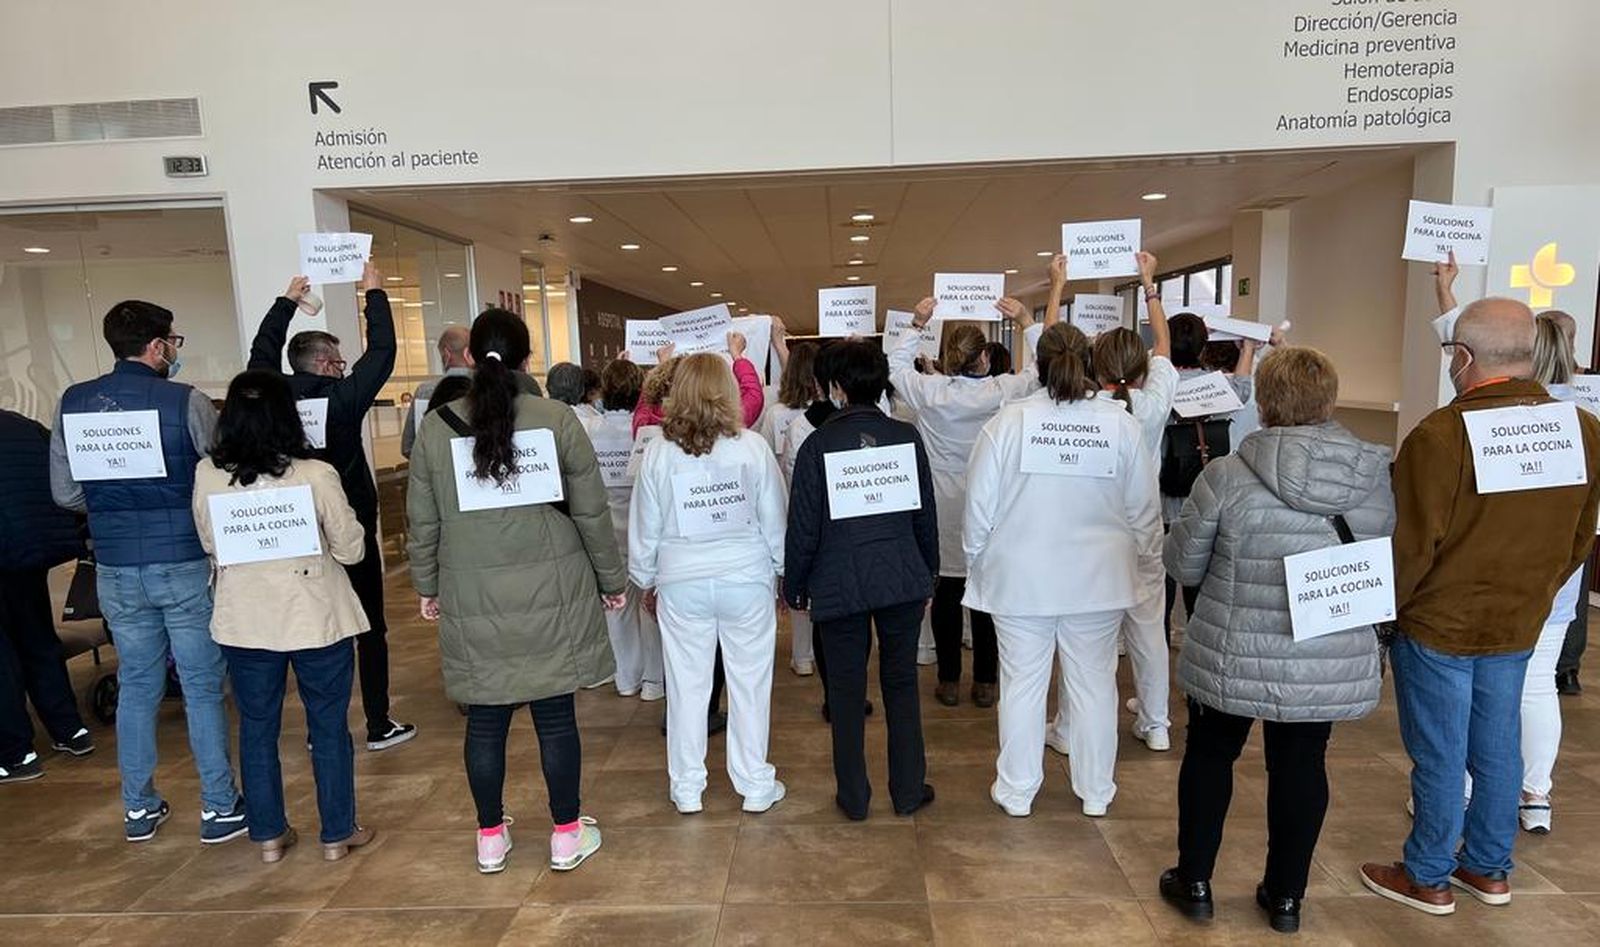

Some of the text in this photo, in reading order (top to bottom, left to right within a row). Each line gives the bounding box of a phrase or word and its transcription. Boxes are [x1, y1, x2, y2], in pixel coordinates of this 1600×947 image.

[1294, 9, 1457, 32] Dirección/Gerencia
[1284, 33, 1456, 58] Medicina preventiva
[1344, 58, 1455, 79] Hemoterapia
[1347, 83, 1453, 103] Endoscopias
[1276, 107, 1451, 131] Anatomía patológica
[315, 128, 387, 146] Admisión
[317, 149, 479, 170] Atención al paciente
[1422, 215, 1474, 228] SOLUCIONES
[1076, 233, 1125, 243] SOLUCIONES
[1413, 226, 1482, 240] PARA LA COCINA
[313, 244, 357, 252] SOLUCIONES
[1070, 245, 1133, 256] PARA LA COCINA
[1436, 244, 1452, 253] YA!!
[339, 253, 363, 262] COCINA
[82, 426, 142, 438] SOLUCIONES
[1041, 422, 1101, 434] SOLUCIONES
[1491, 421, 1561, 438] SOLUCIONES
[75, 440, 153, 453] PARA LA COCINA
[1030, 435, 1110, 449] PARA LA COCINA
[1482, 439, 1573, 457] PARA LA COCINA
[106, 457, 126, 468] YA!!
[1059, 453, 1079, 465] YA!!
[842, 460, 899, 476] SOLUCIONES
[1519, 461, 1544, 475] YA!!
[500, 481, 521, 495] YA!!
[689, 480, 740, 496] SOLUCIONES
[835, 474, 910, 491] PARA LA COCINA
[683, 493, 746, 510] PARA LA COCINA
[863, 492, 883, 504] YA!!
[230, 502, 295, 519] SOLUCIONES
[711, 511, 728, 522] YA!!
[223, 517, 308, 535] PARA LA COCINA
[257, 536, 279, 550] YA!!
[1304, 560, 1370, 583] SOLUCIONES
[1297, 576, 1383, 603] PARA LA COCINA
[1328, 602, 1351, 618] YA!!
